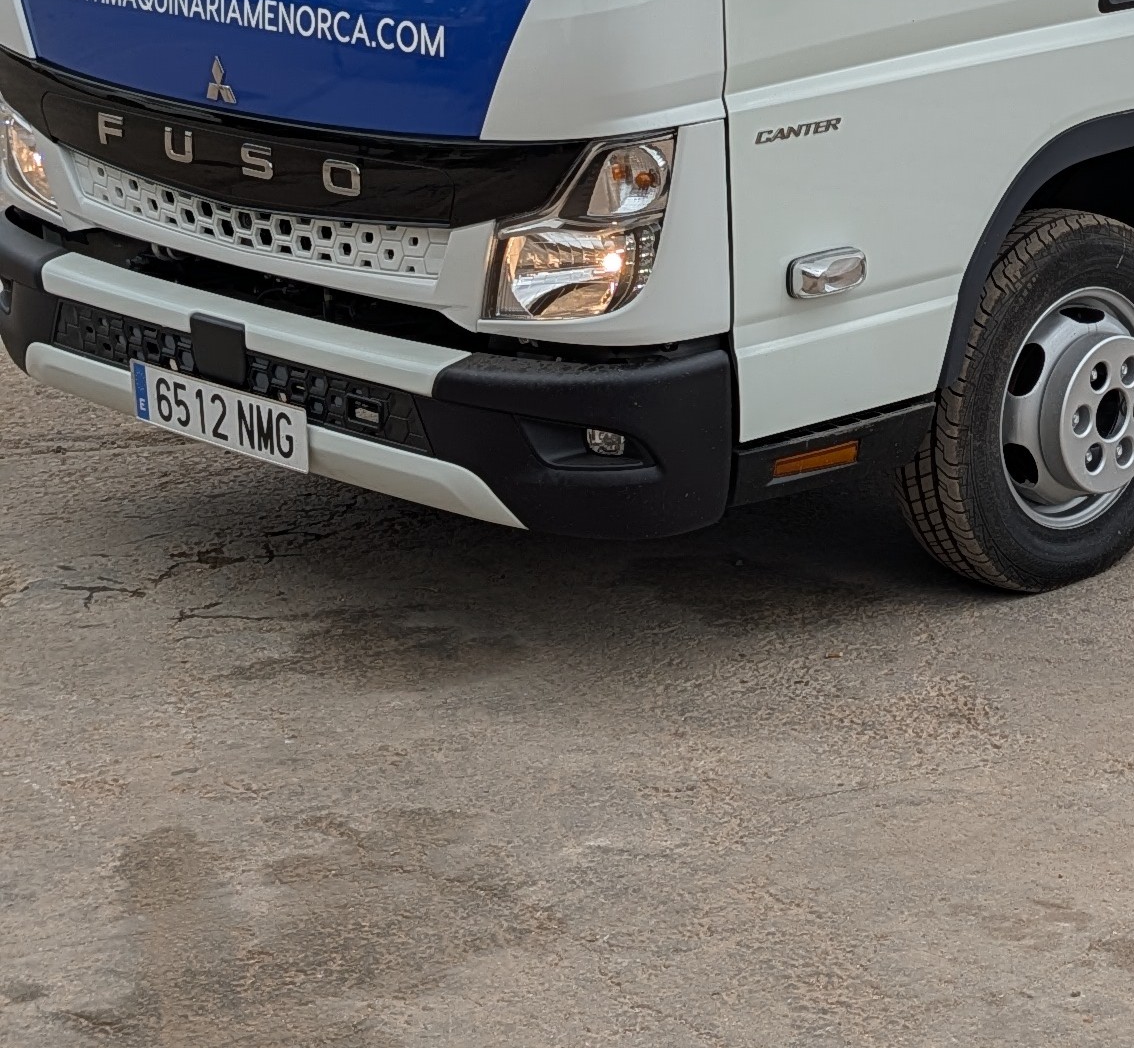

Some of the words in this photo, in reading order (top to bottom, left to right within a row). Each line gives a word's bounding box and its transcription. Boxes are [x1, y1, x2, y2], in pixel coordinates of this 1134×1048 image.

[98, 111, 361, 197] FUSO
[755, 117, 842, 145] CANTER
[139, 397, 146, 411] E
[155, 377, 229, 442] 6512
[237, 399, 294, 459] NMG
